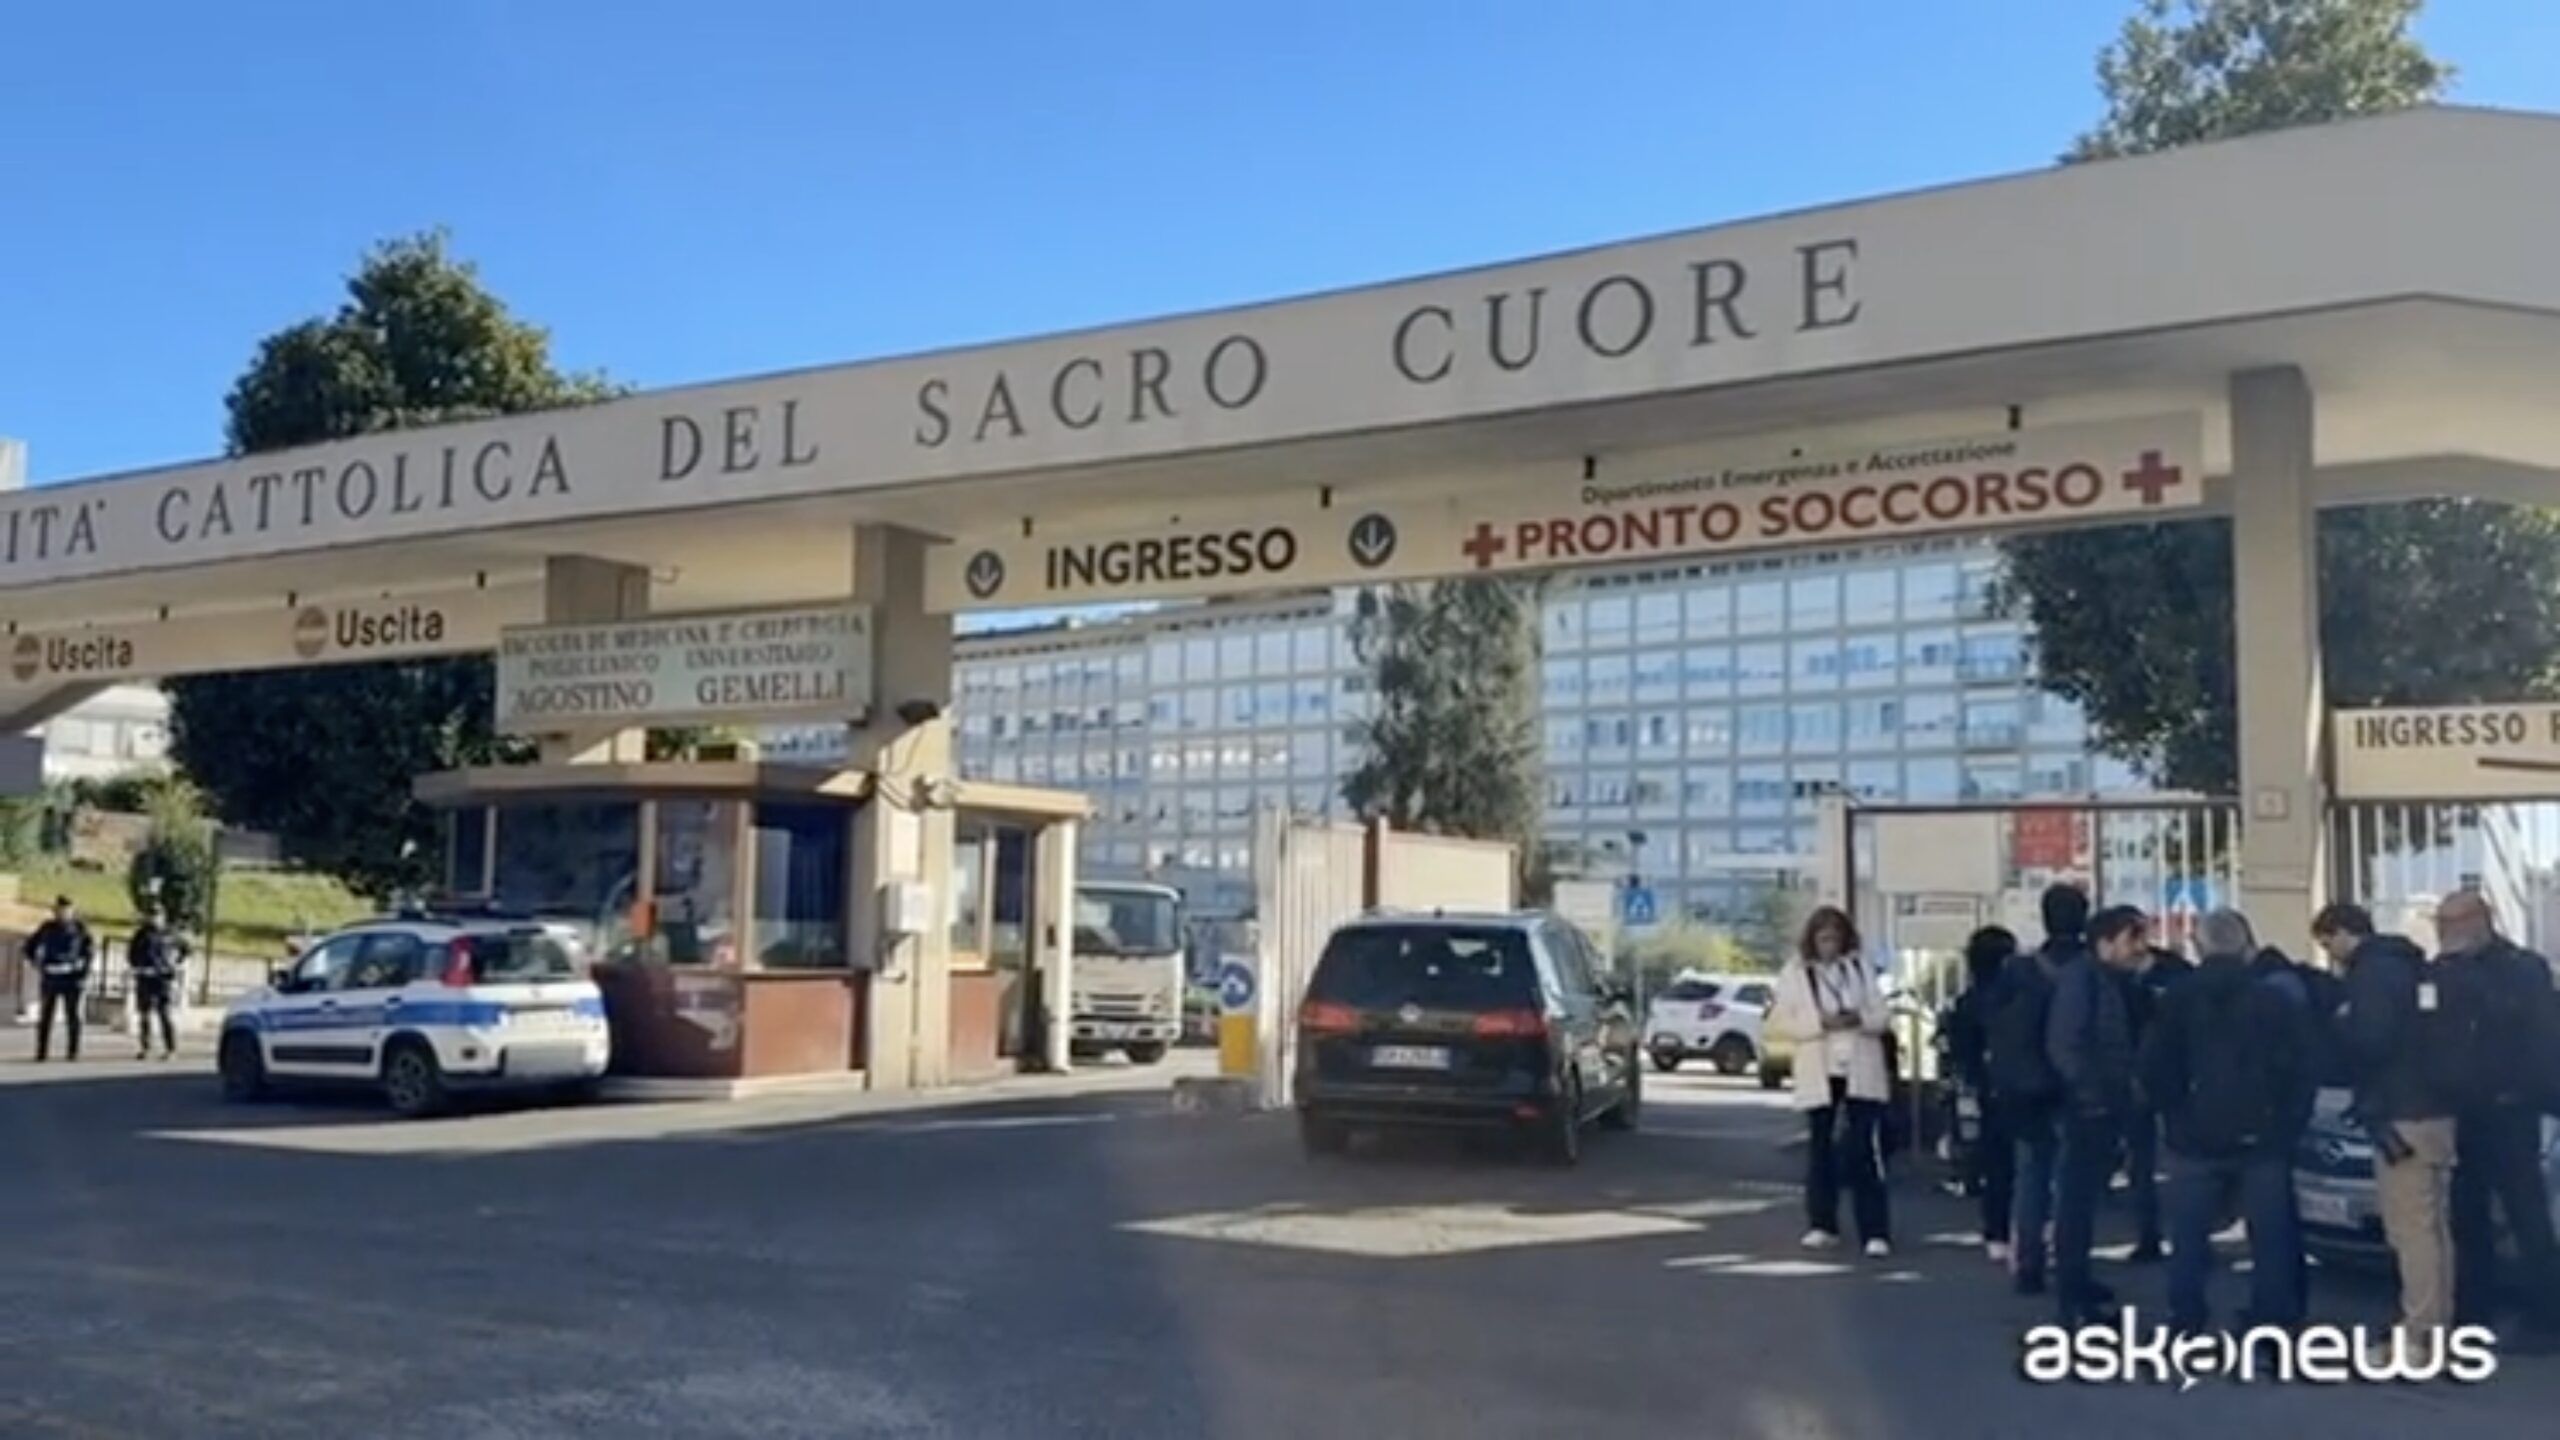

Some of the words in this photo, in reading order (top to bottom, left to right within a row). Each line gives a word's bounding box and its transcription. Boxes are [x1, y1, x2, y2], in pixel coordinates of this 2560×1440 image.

[157, 435, 571, 541] CATTOLICA
[659, 401, 820, 481] DEL
[915, 335, 1268, 448] SACRO
[1392, 238, 1863, 383] CUORE
[1581, 475, 1715, 505] Dipartimento
[1721, 460, 1840, 488] Emergenza
[1845, 457, 1859, 475] e
[1867, 440, 2017, 473] Accettazione
[1516, 502, 1741, 560] PRONTO
[1759, 462, 2103, 537] SOCCORSO
[1046, 526, 1297, 590] INGRESSO
[47, 637, 133, 672] Uscita
[336, 604, 443, 648] Uscita
[2356, 711, 2528, 749] INGRESSO
